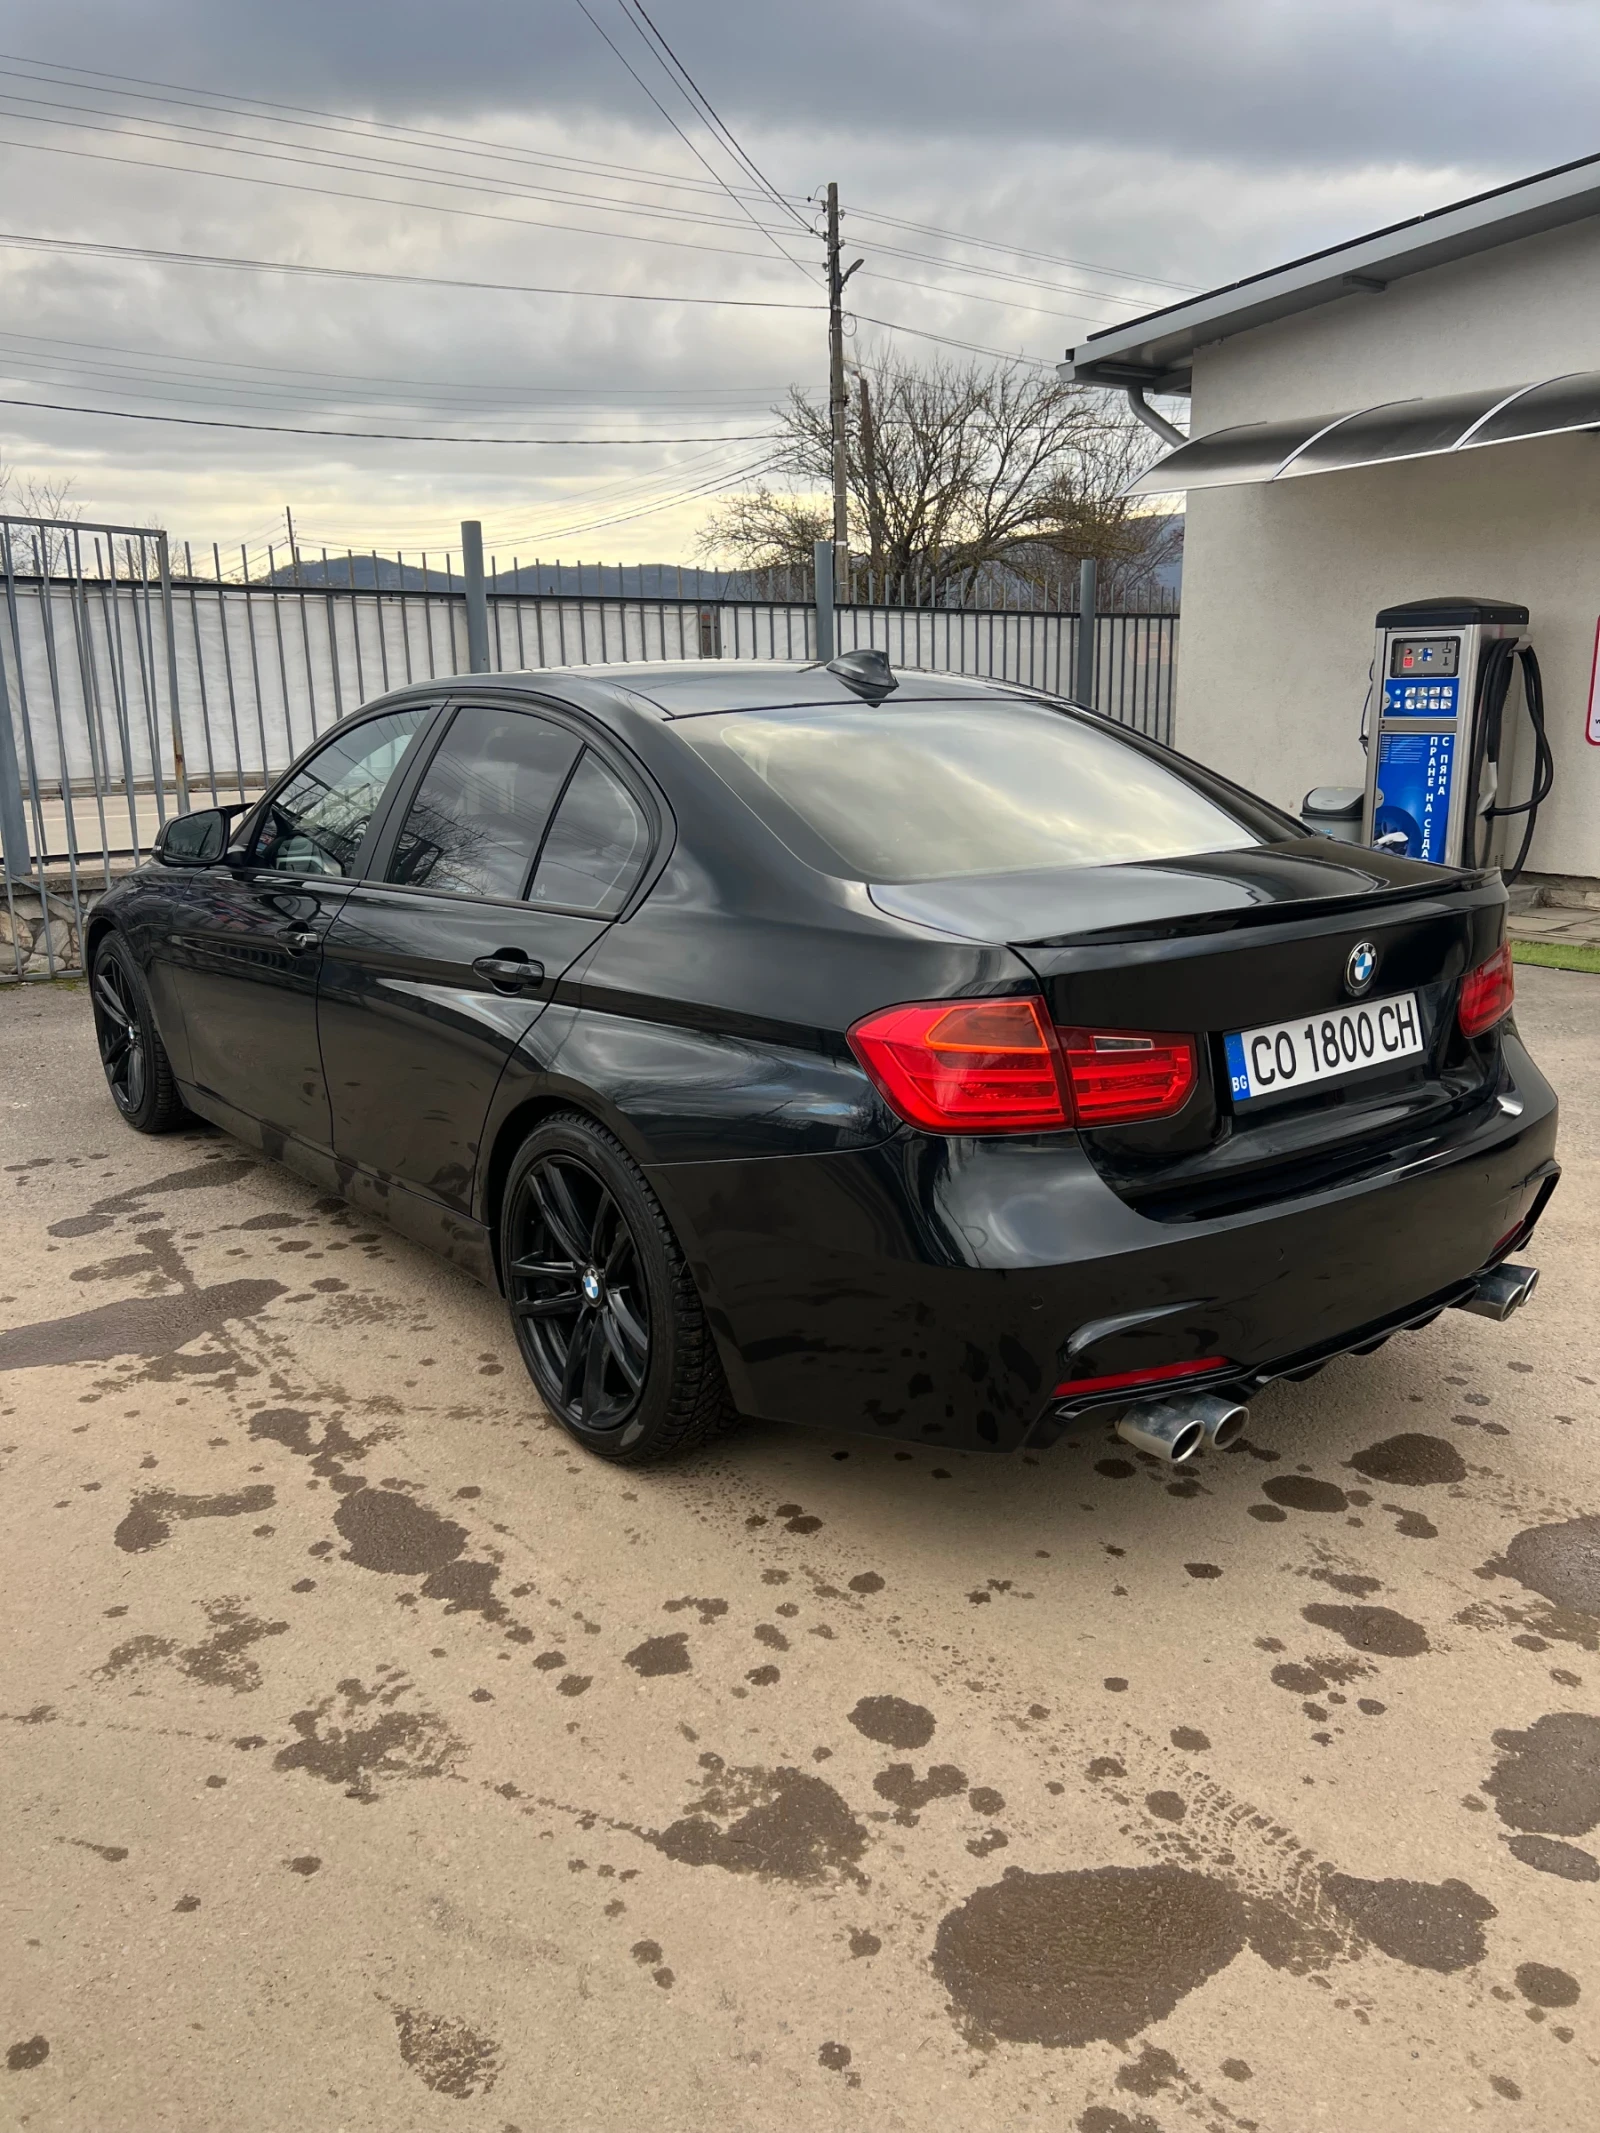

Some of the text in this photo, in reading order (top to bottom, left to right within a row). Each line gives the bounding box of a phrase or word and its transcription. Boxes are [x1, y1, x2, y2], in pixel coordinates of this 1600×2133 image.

[1421, 736, 1438, 861] ПРАНЕ НА СЕДА
[1437, 737, 1450, 795] С ПЯНА
[1251, 1000, 1417, 1086] CO 1800 CH
[1231, 1075, 1248, 1092] BG
